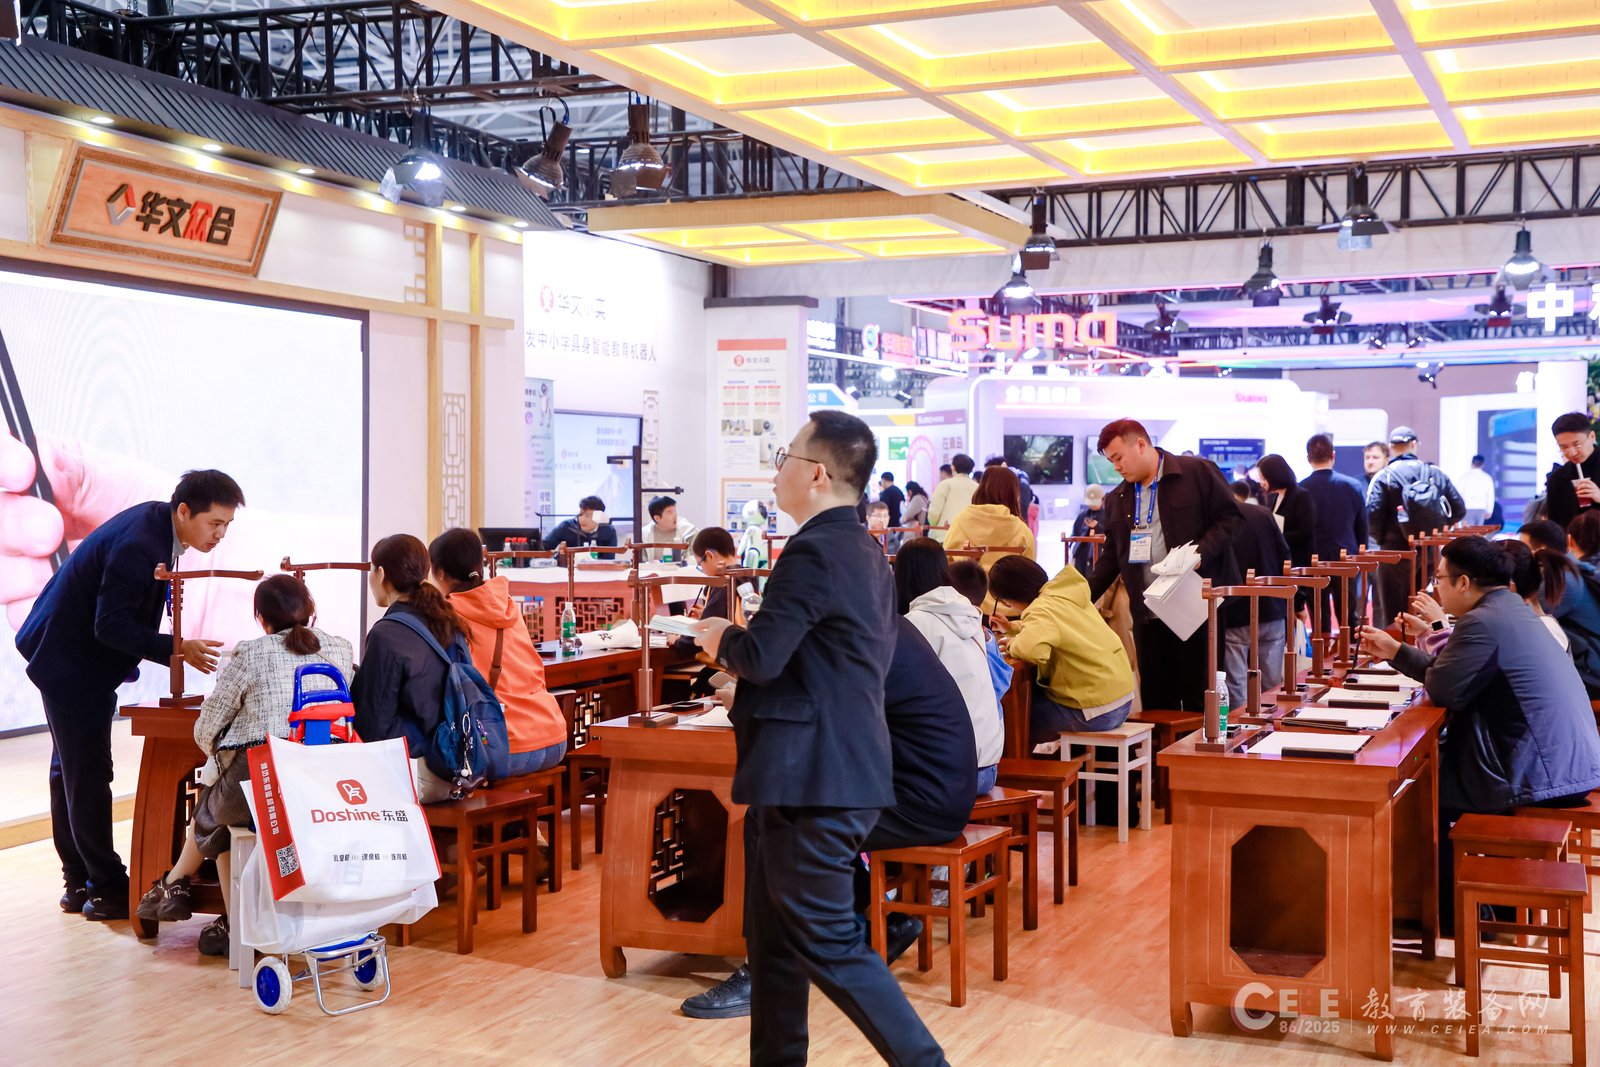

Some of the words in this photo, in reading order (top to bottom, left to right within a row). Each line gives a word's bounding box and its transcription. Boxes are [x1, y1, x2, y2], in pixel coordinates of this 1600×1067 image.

[135, 191, 236, 246] 华文众合
[311, 808, 380, 824] Doshine
[382, 810, 409, 823] 东盛
